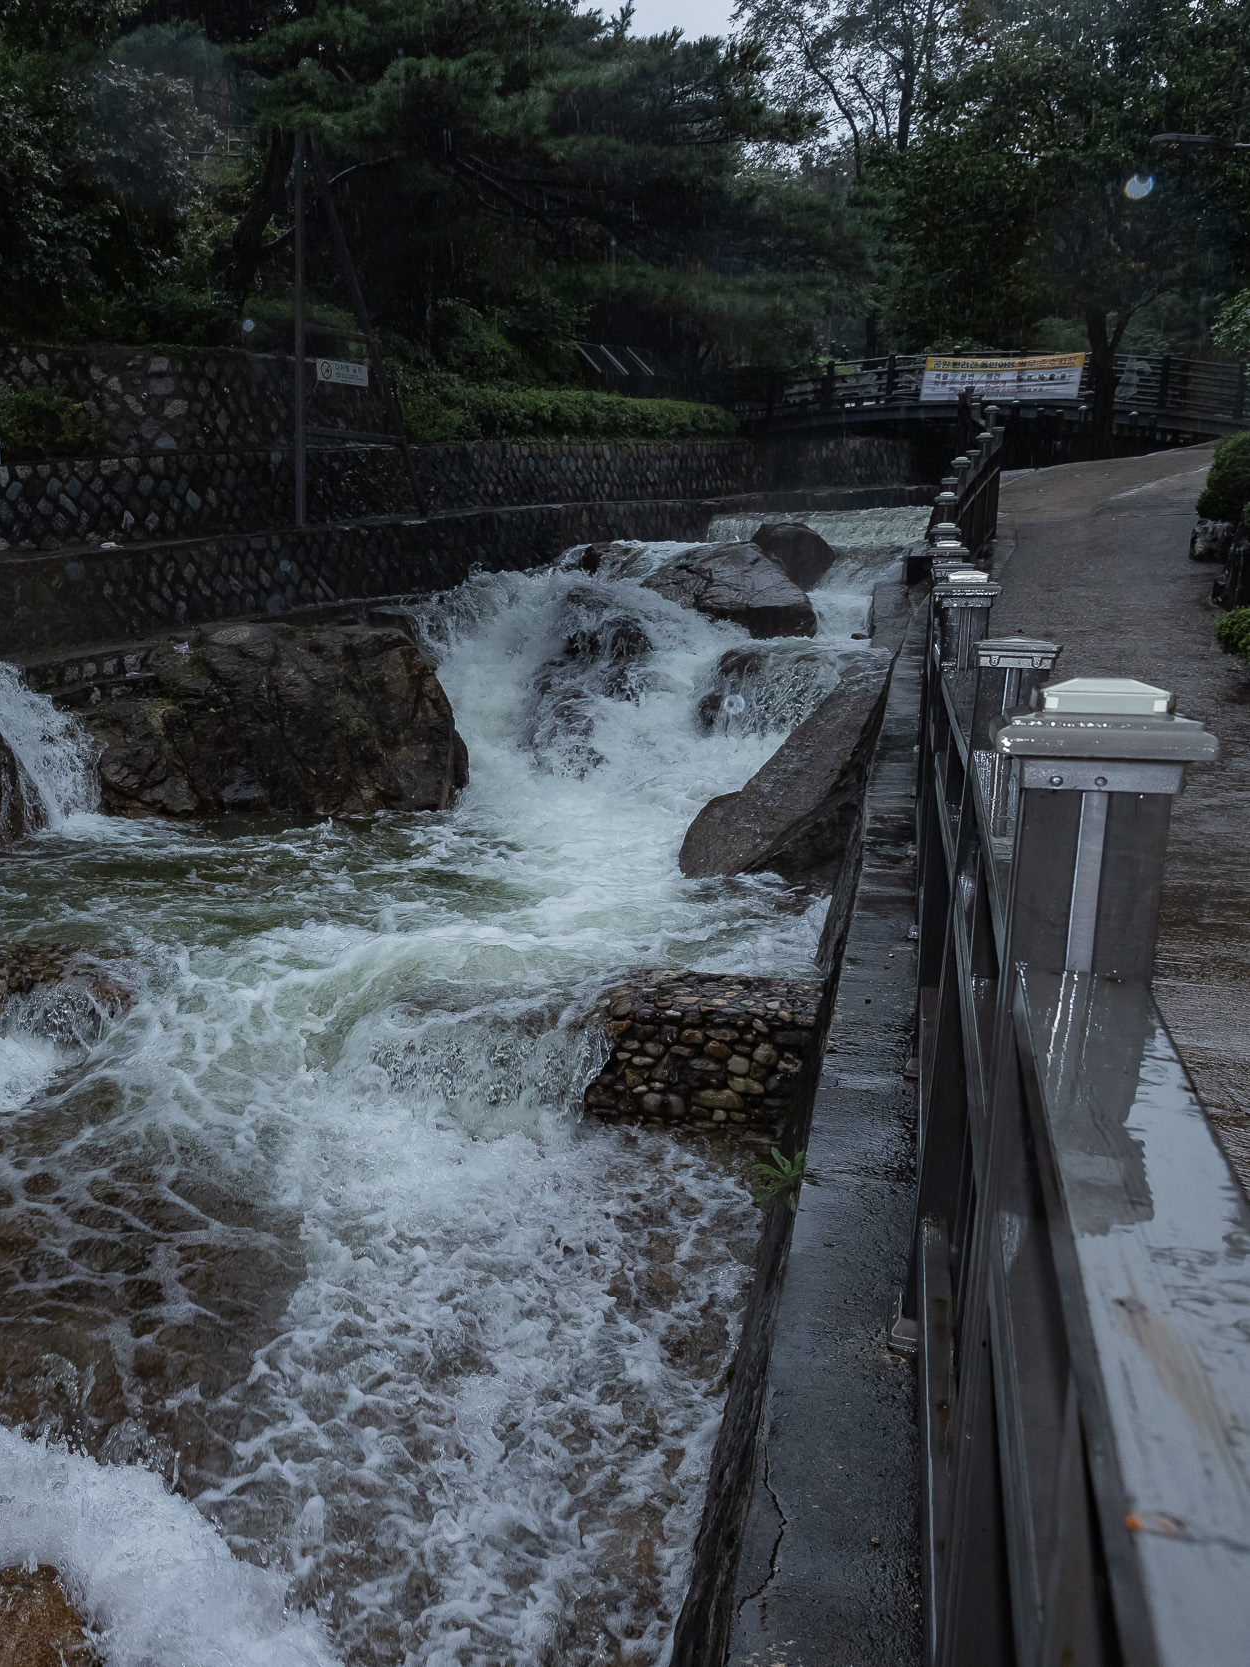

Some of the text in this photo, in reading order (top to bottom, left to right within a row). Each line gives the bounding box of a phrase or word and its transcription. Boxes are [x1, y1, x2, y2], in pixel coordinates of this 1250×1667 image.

[334, 363, 350, 373] 다이빙
[933, 361, 950, 369] 공원
[952, 361, 978, 369] 반려견
[1038, 356, 1077, 367] 준수사항
